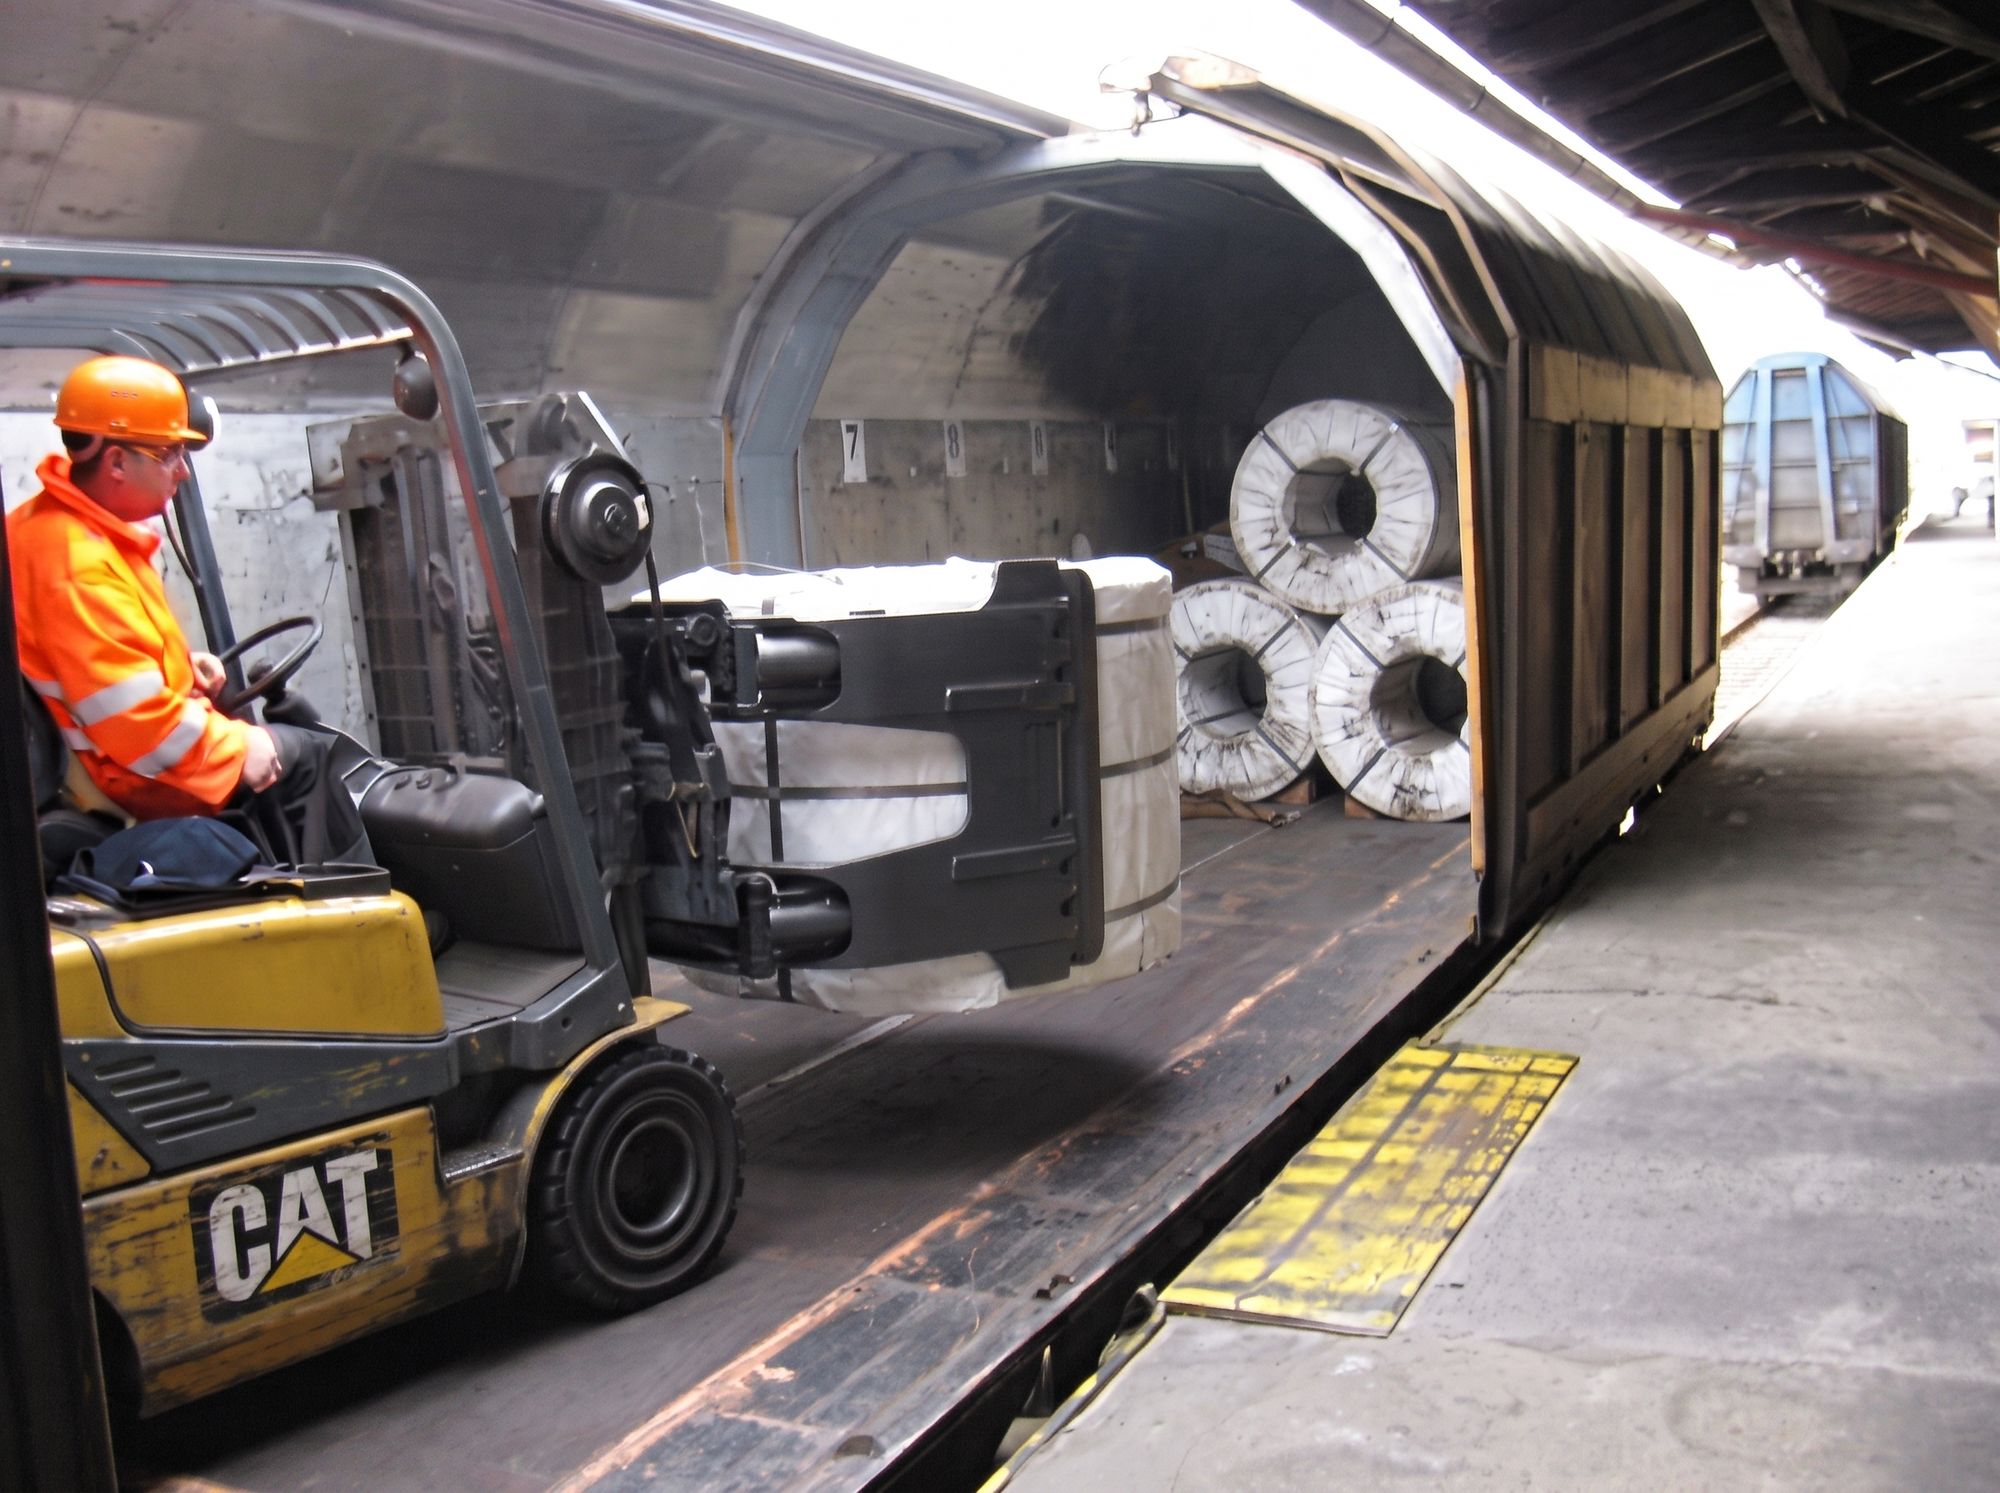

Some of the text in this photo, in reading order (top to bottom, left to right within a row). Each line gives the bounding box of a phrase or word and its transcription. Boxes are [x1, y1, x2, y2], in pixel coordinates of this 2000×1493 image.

[845, 423, 859, 461] 7
[947, 423, 960, 459] 8
[209, 1148, 378, 1302] CAT
